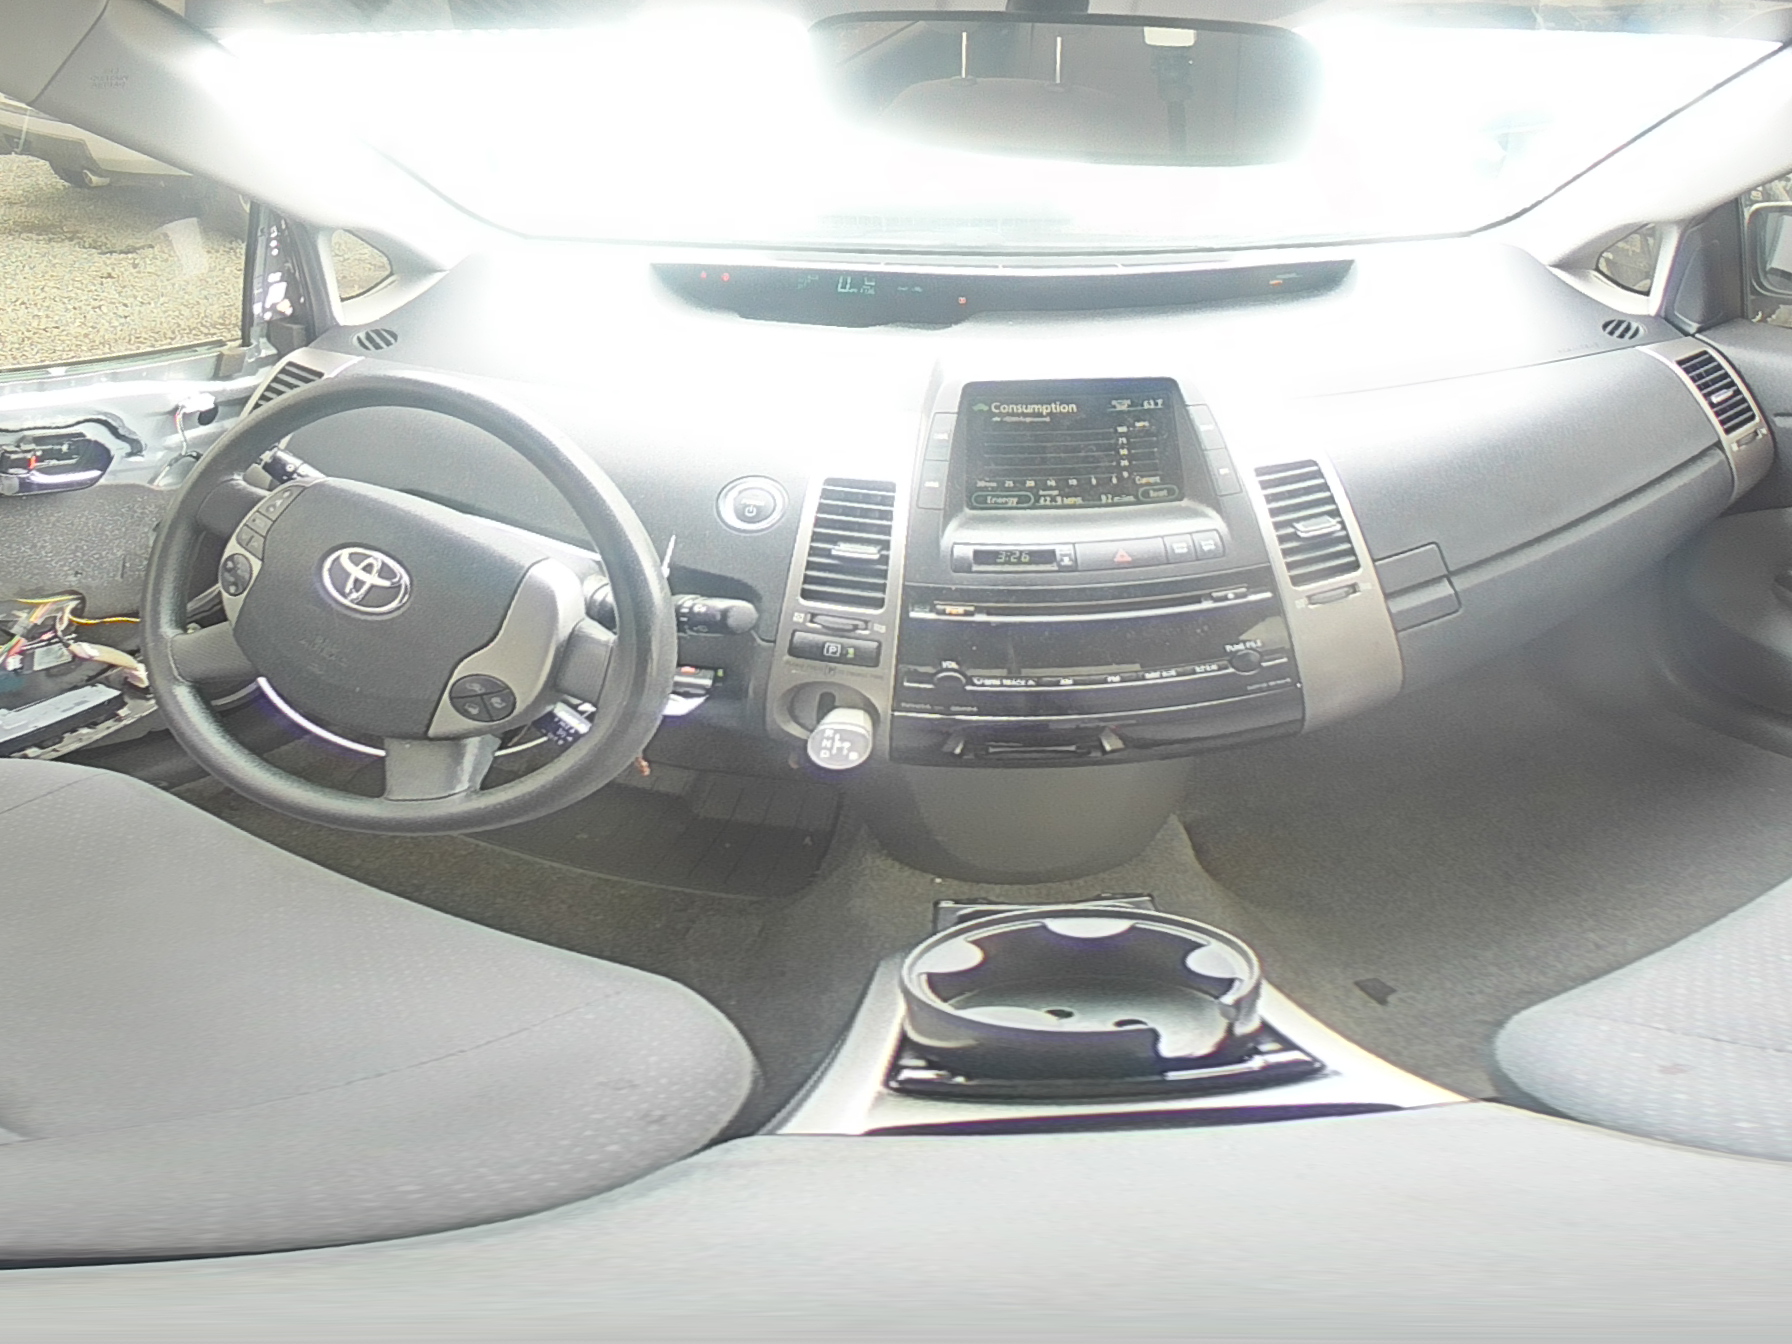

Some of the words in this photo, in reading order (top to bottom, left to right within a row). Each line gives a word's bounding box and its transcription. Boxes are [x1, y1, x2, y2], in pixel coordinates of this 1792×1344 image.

[991, 401, 1078, 416] Consumption
[987, 496, 1019, 507] Energy
[995, 550, 1030, 563] 3:26
